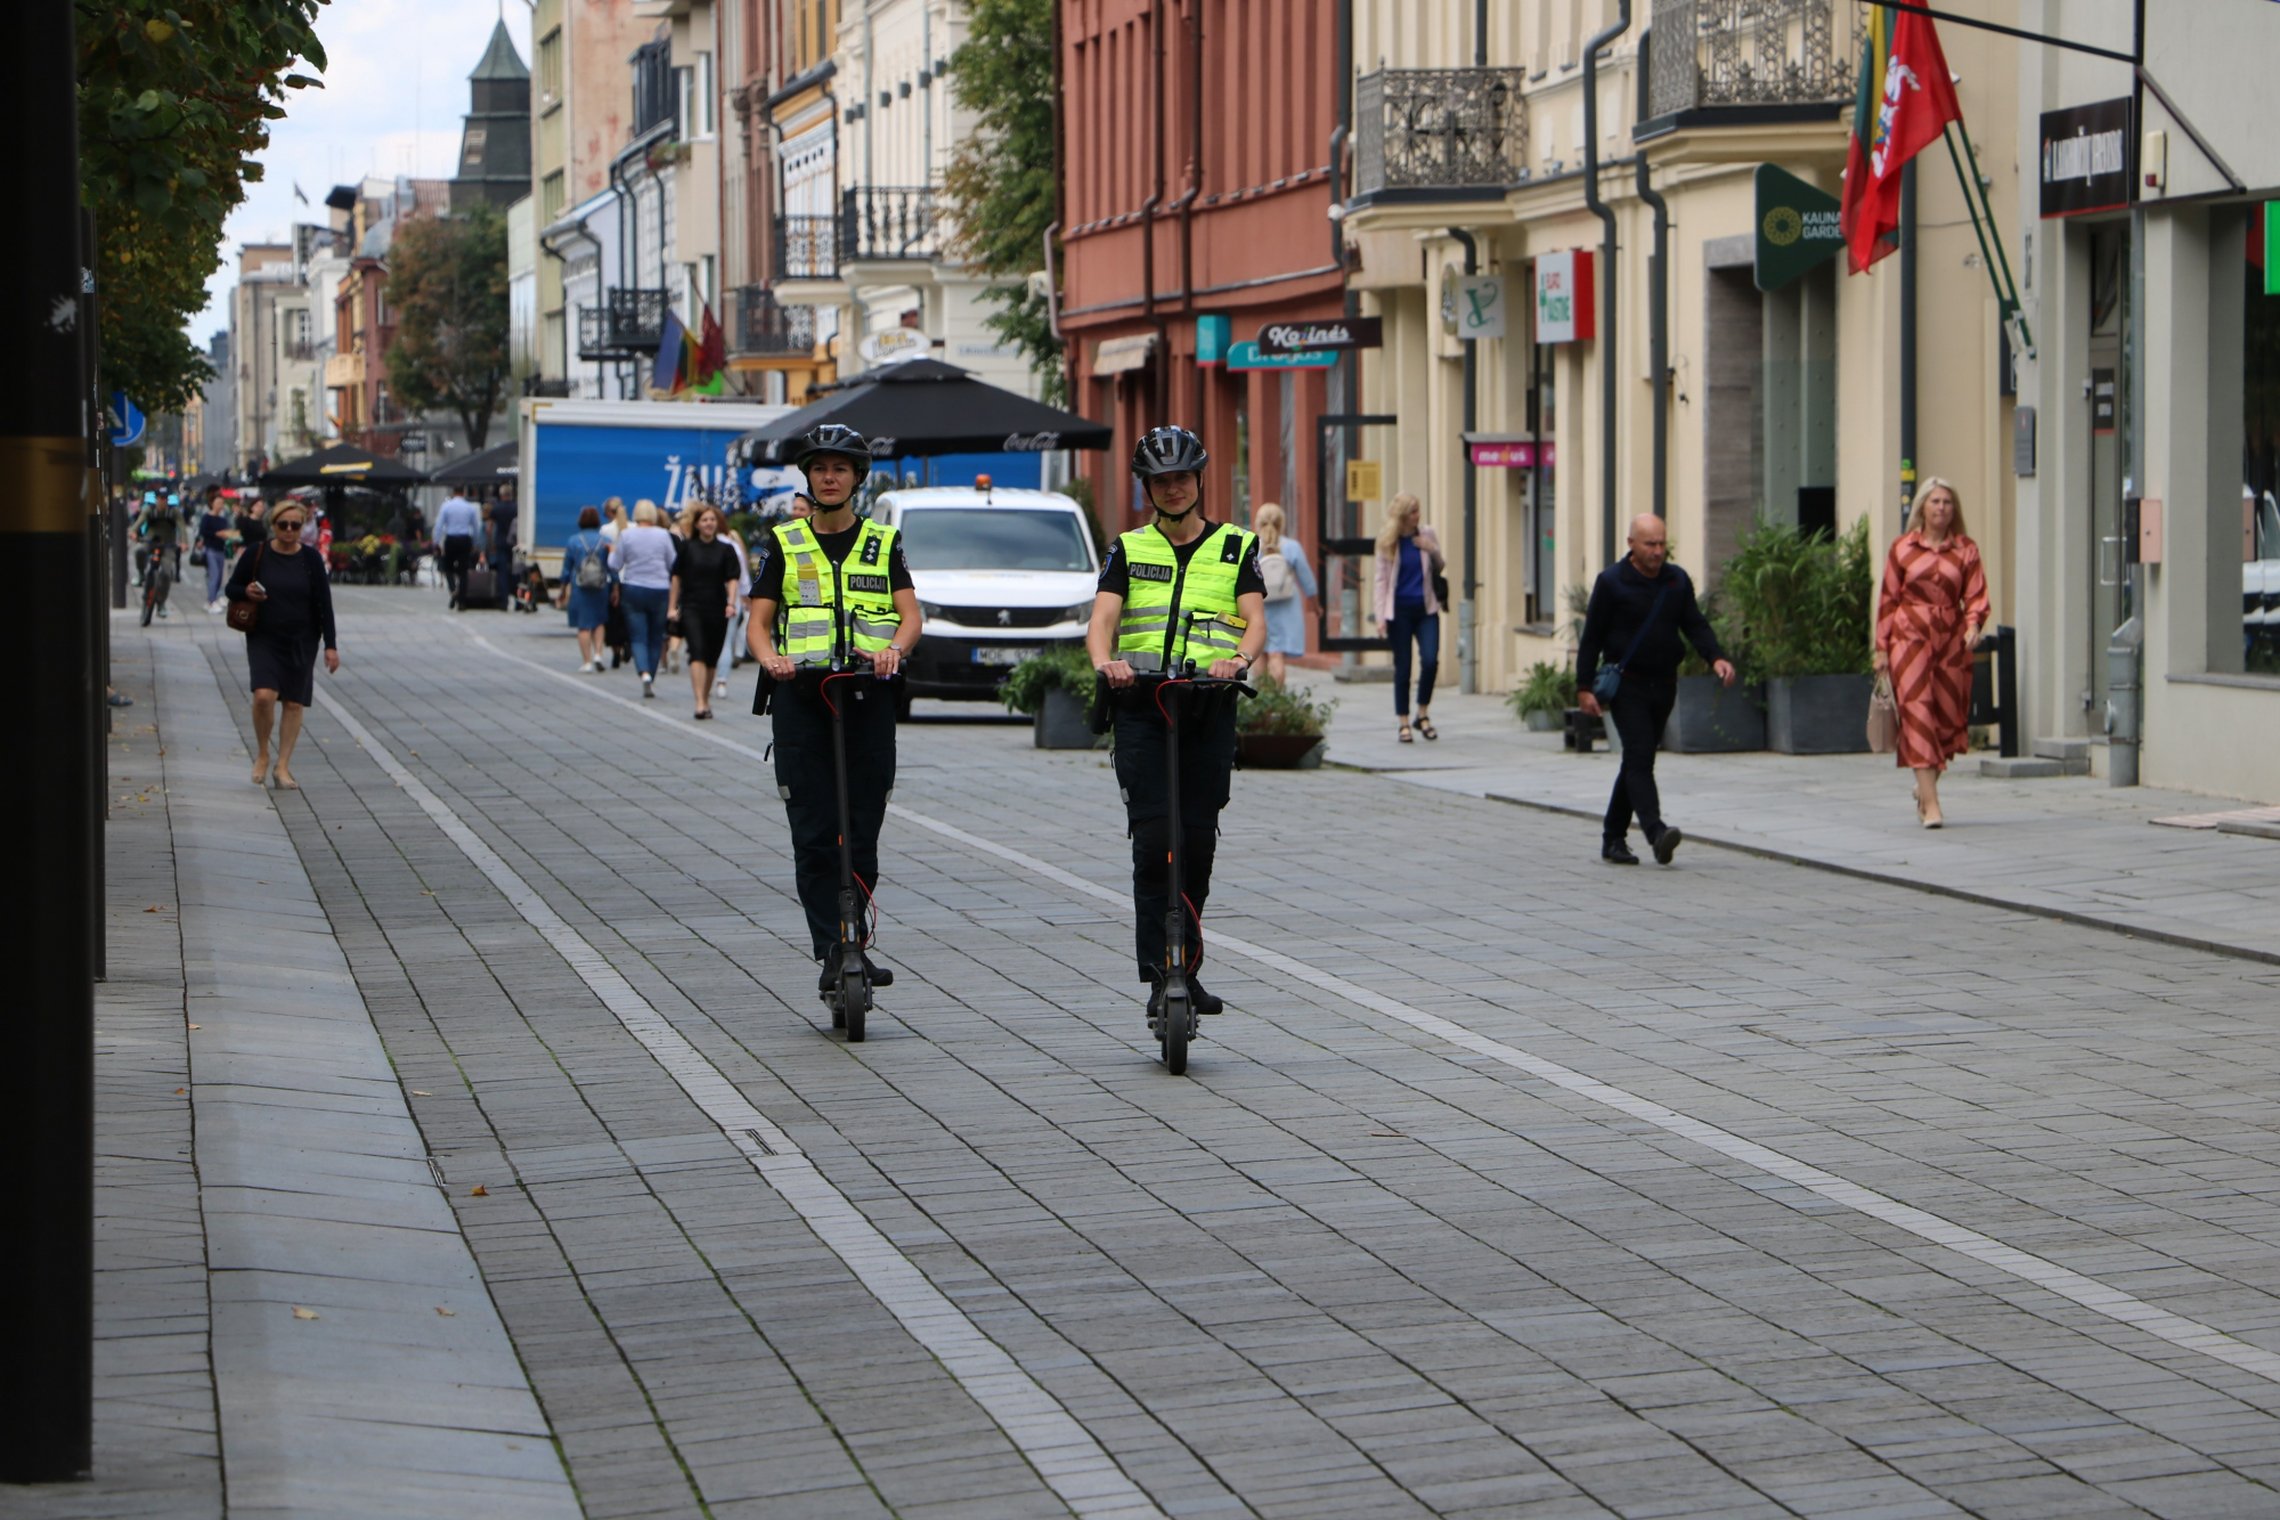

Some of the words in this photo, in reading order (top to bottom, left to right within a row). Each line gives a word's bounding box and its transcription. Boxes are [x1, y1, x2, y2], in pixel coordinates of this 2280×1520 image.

[1802, 211, 1842, 224] KAUNA
[1802, 225, 1842, 239] GARDE
[1130, 563, 1170, 580] POLICIJA
[850, 576, 886, 590] POLICIJA
